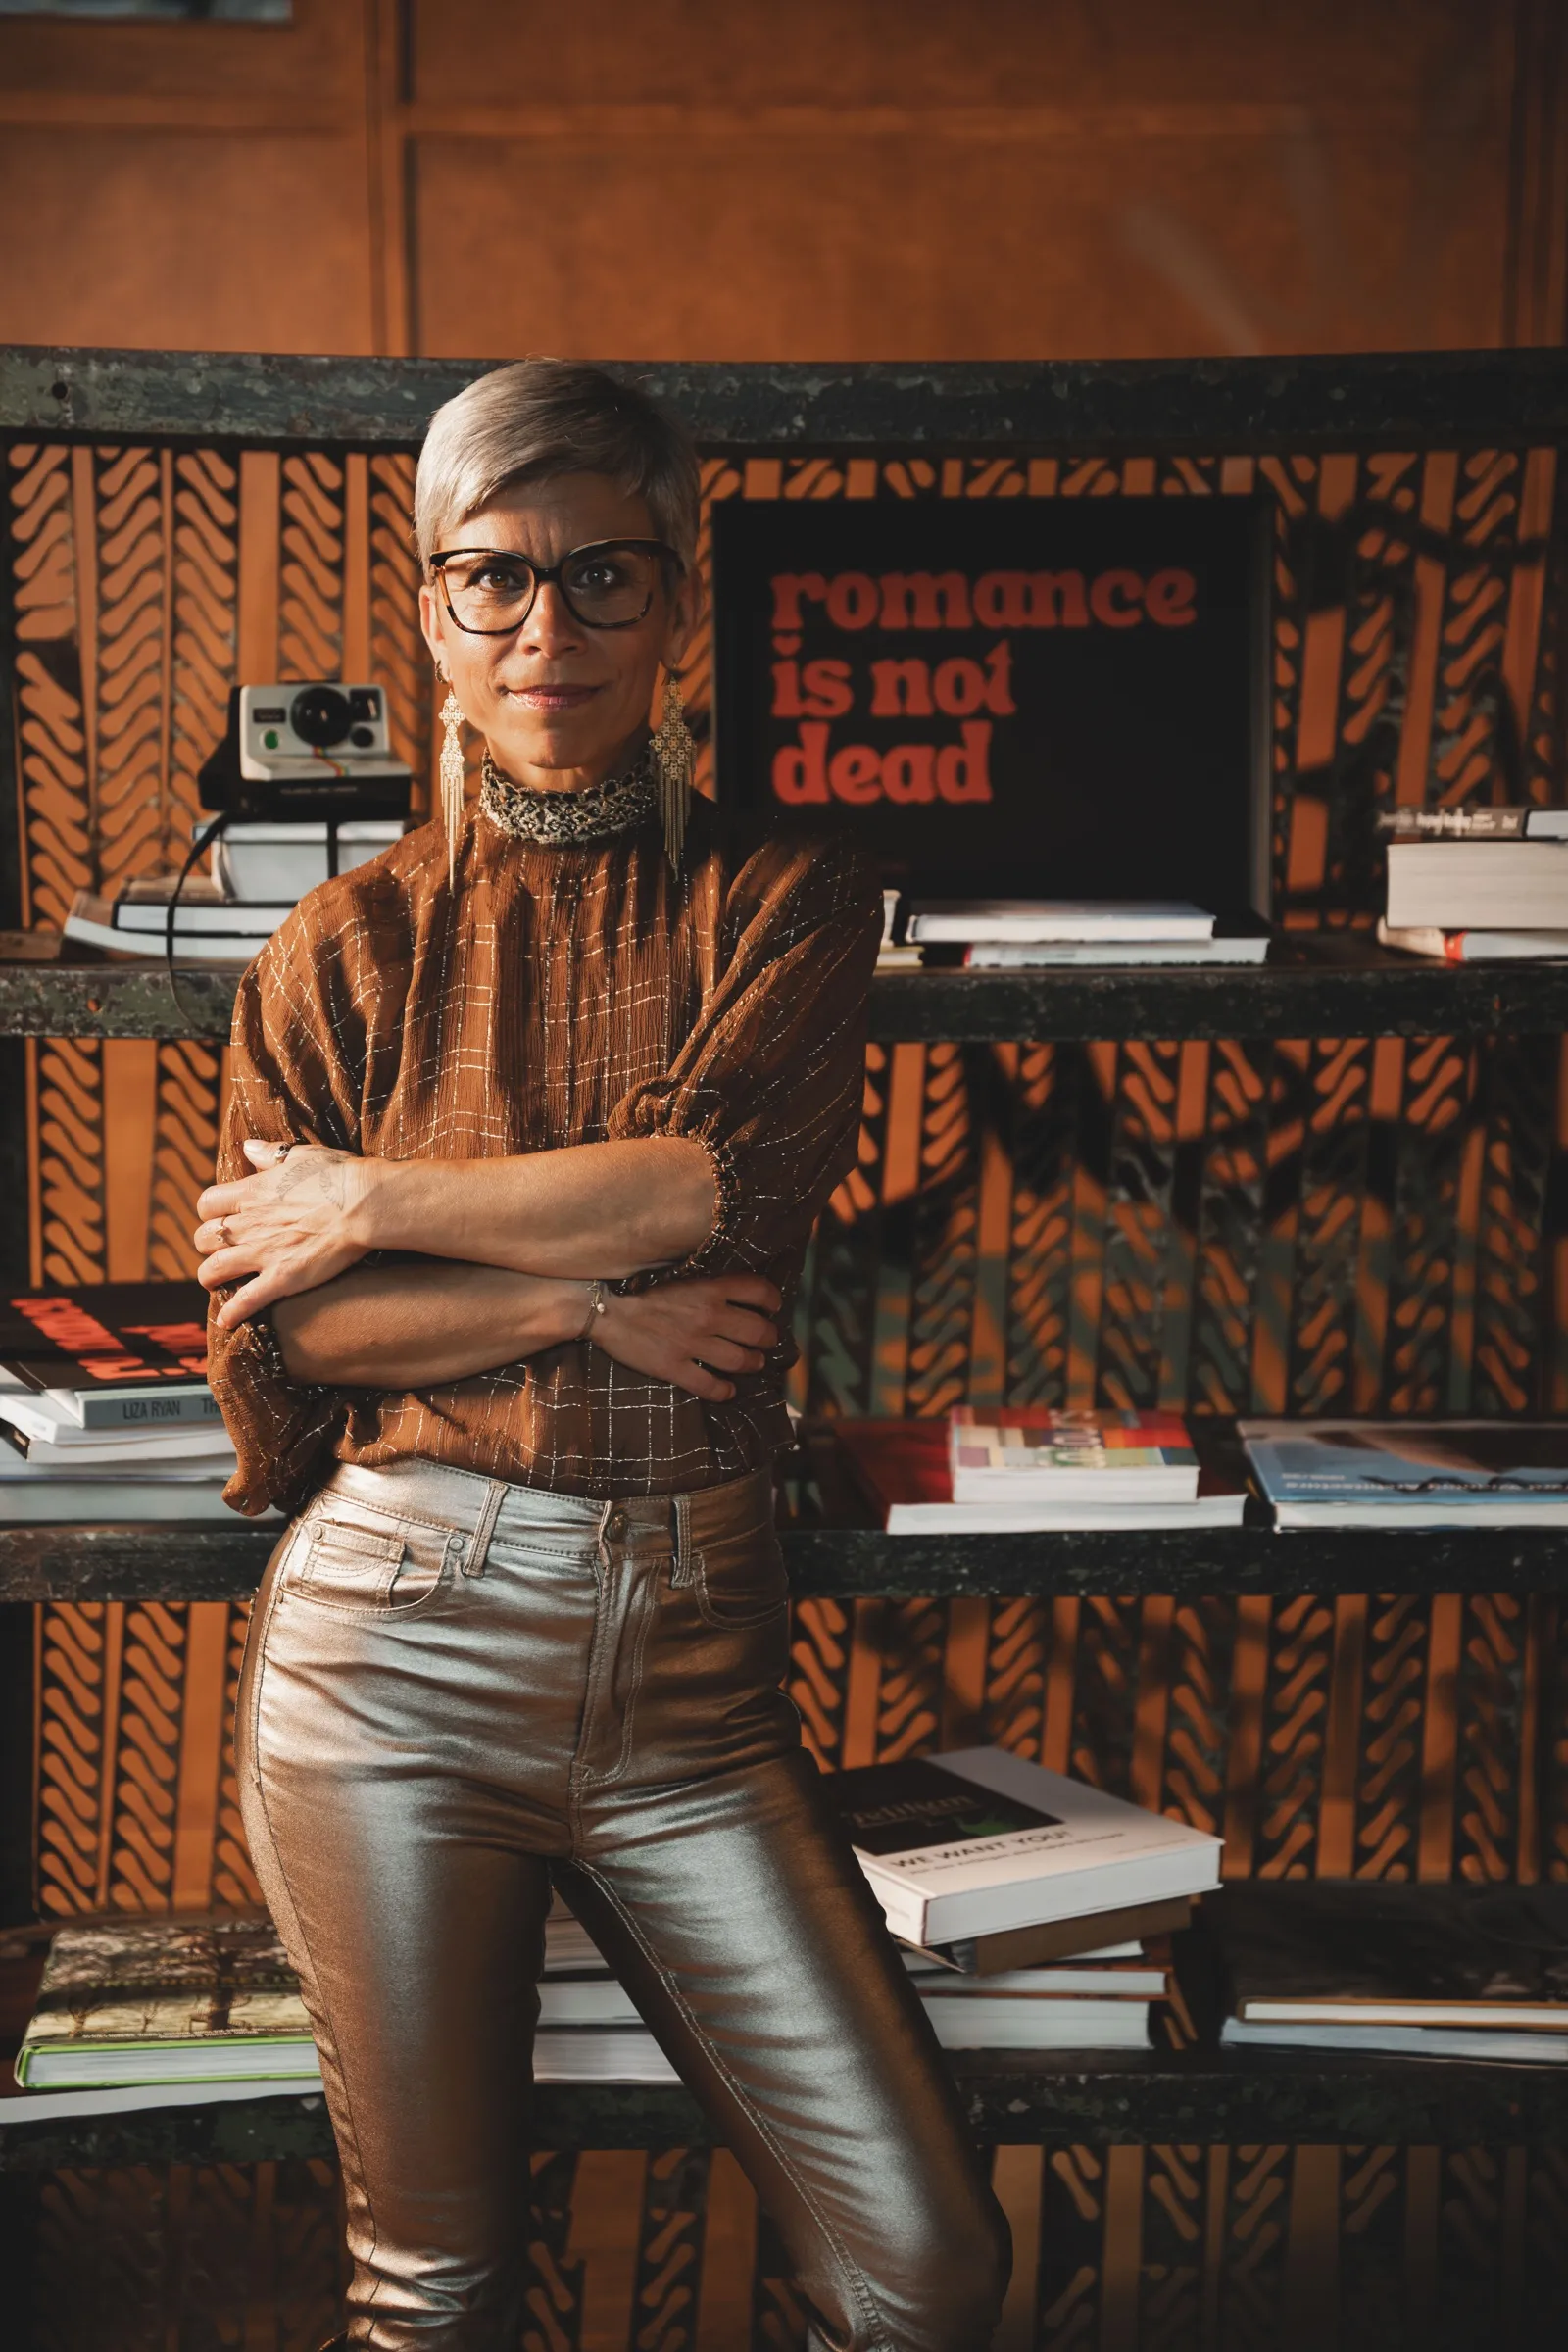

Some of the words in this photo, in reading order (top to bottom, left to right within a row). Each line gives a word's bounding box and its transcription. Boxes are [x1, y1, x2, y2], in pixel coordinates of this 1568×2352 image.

[771, 568, 1197, 631] romance
[771, 634, 855, 718] is
[870, 639, 1017, 717] not
[771, 720, 993, 805] dead
[122, 1401, 148, 1420] LIZA
[151, 1399, 181, 1418] RYAN
[890, 1854, 931, 1869] WE
[934, 1841, 1006, 1859] WANT
